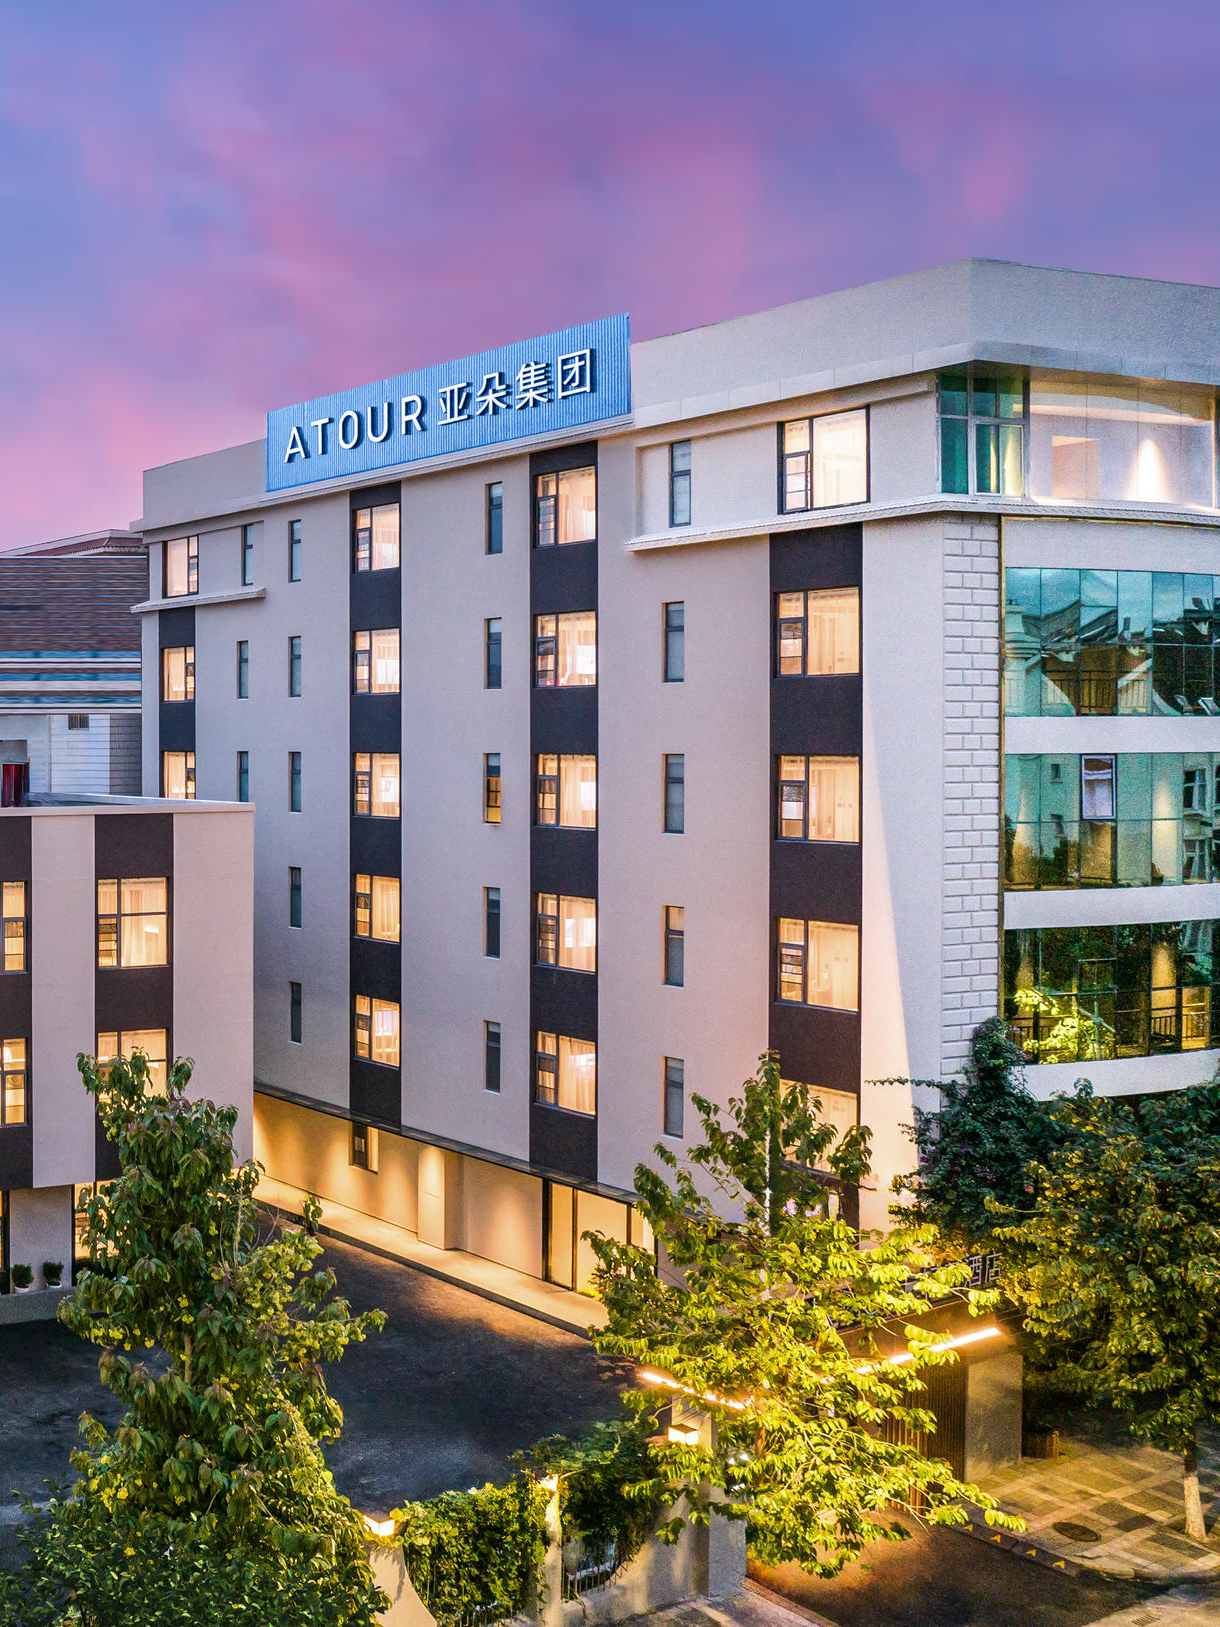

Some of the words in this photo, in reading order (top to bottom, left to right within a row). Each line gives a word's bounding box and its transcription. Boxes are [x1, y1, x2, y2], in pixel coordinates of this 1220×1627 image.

[283, 394, 424, 464] ATOUR
[437, 348, 592, 426] 亚朵集团
